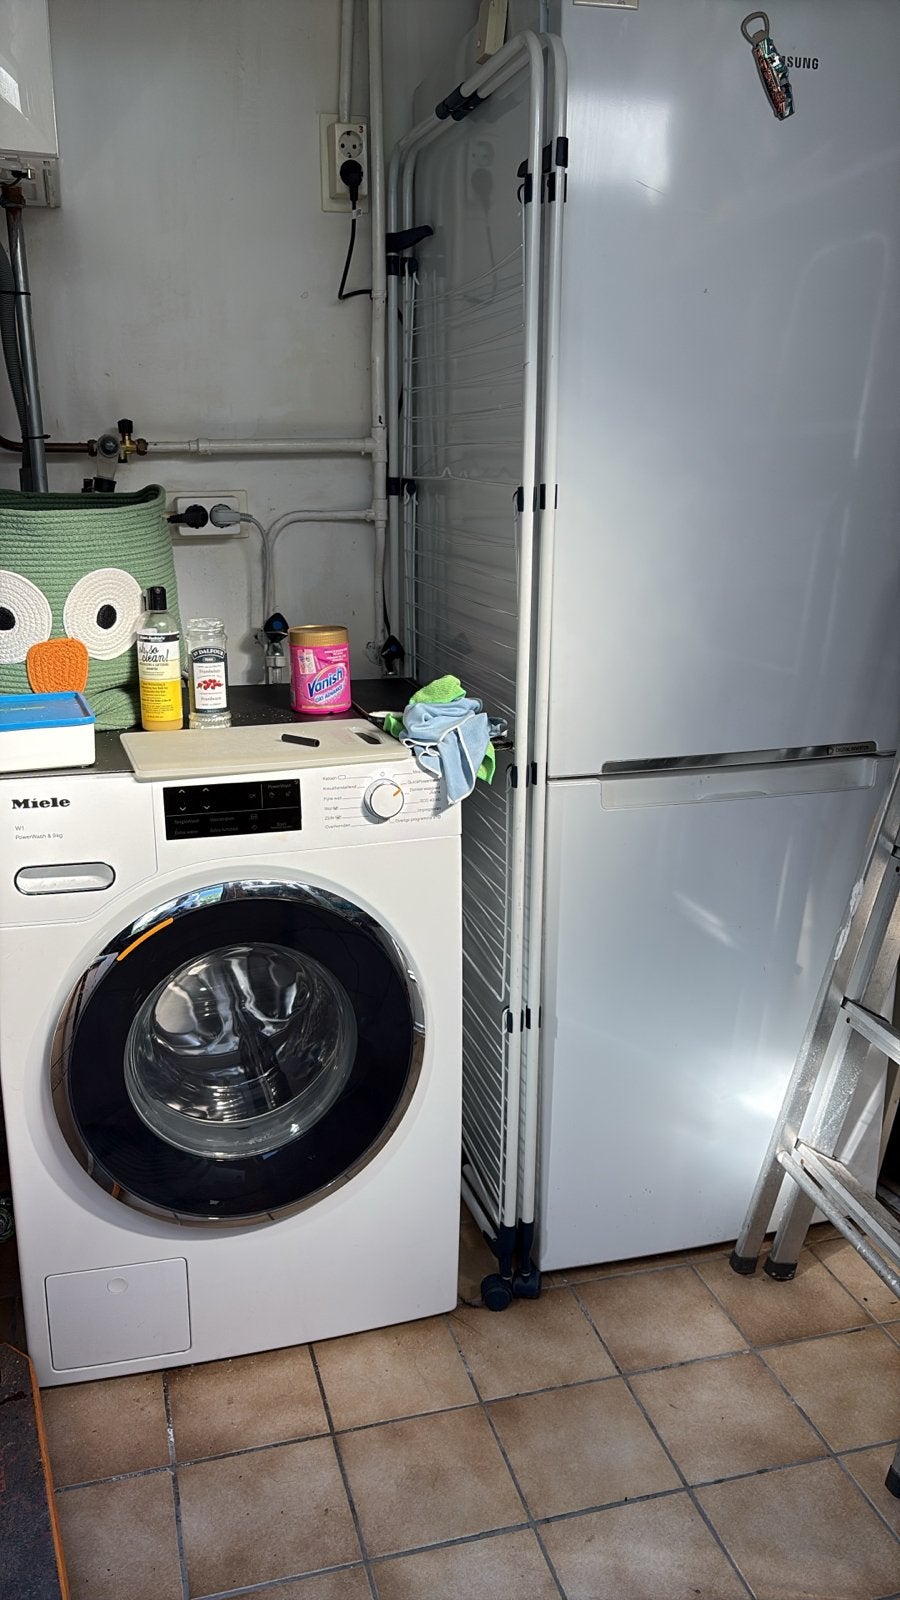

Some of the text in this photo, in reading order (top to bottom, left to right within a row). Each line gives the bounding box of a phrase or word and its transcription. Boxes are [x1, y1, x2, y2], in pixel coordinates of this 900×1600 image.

[781, 55, 819, 70] SUNG
[142, 649, 169, 662] clean!
[307, 667, 343, 698] Vanish
[11, 797, 71, 810] Miele
